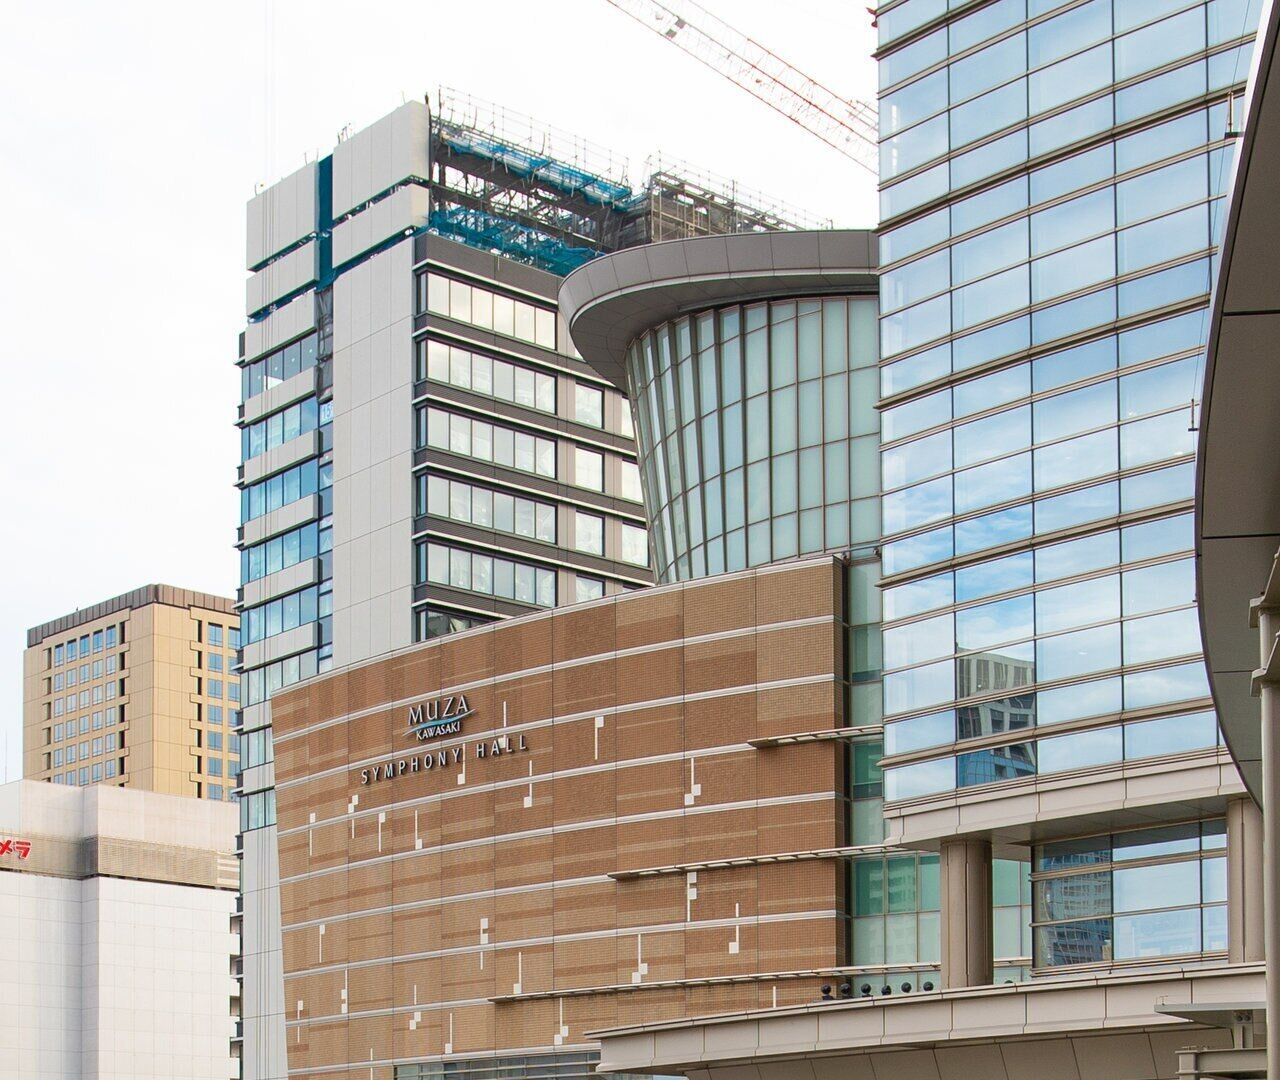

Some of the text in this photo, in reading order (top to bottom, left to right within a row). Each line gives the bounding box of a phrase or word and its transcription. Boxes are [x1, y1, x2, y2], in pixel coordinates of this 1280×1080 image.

[408, 694, 470, 726] MUZA
[415, 721, 461, 741] KAWASAKI
[360, 734, 529, 785] SYMPHONY HALL
